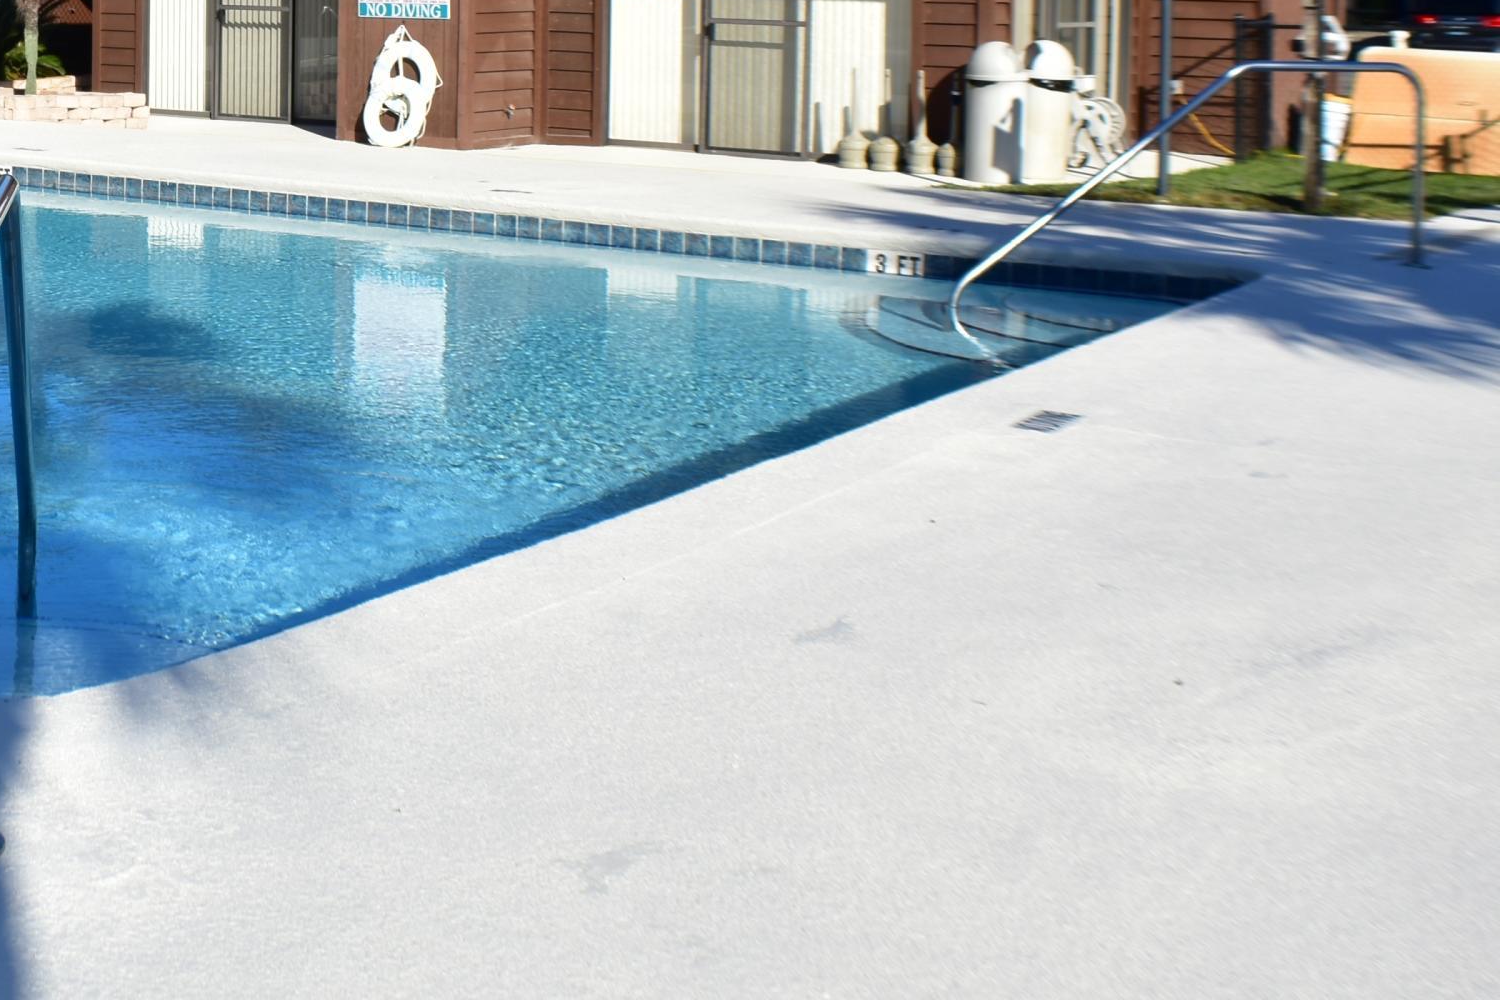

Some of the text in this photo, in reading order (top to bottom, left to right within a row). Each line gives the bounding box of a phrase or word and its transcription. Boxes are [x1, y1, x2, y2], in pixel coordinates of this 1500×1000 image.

[367, 2, 441, 18] NO DIVING
[875, 253, 921, 277] 3 FT
